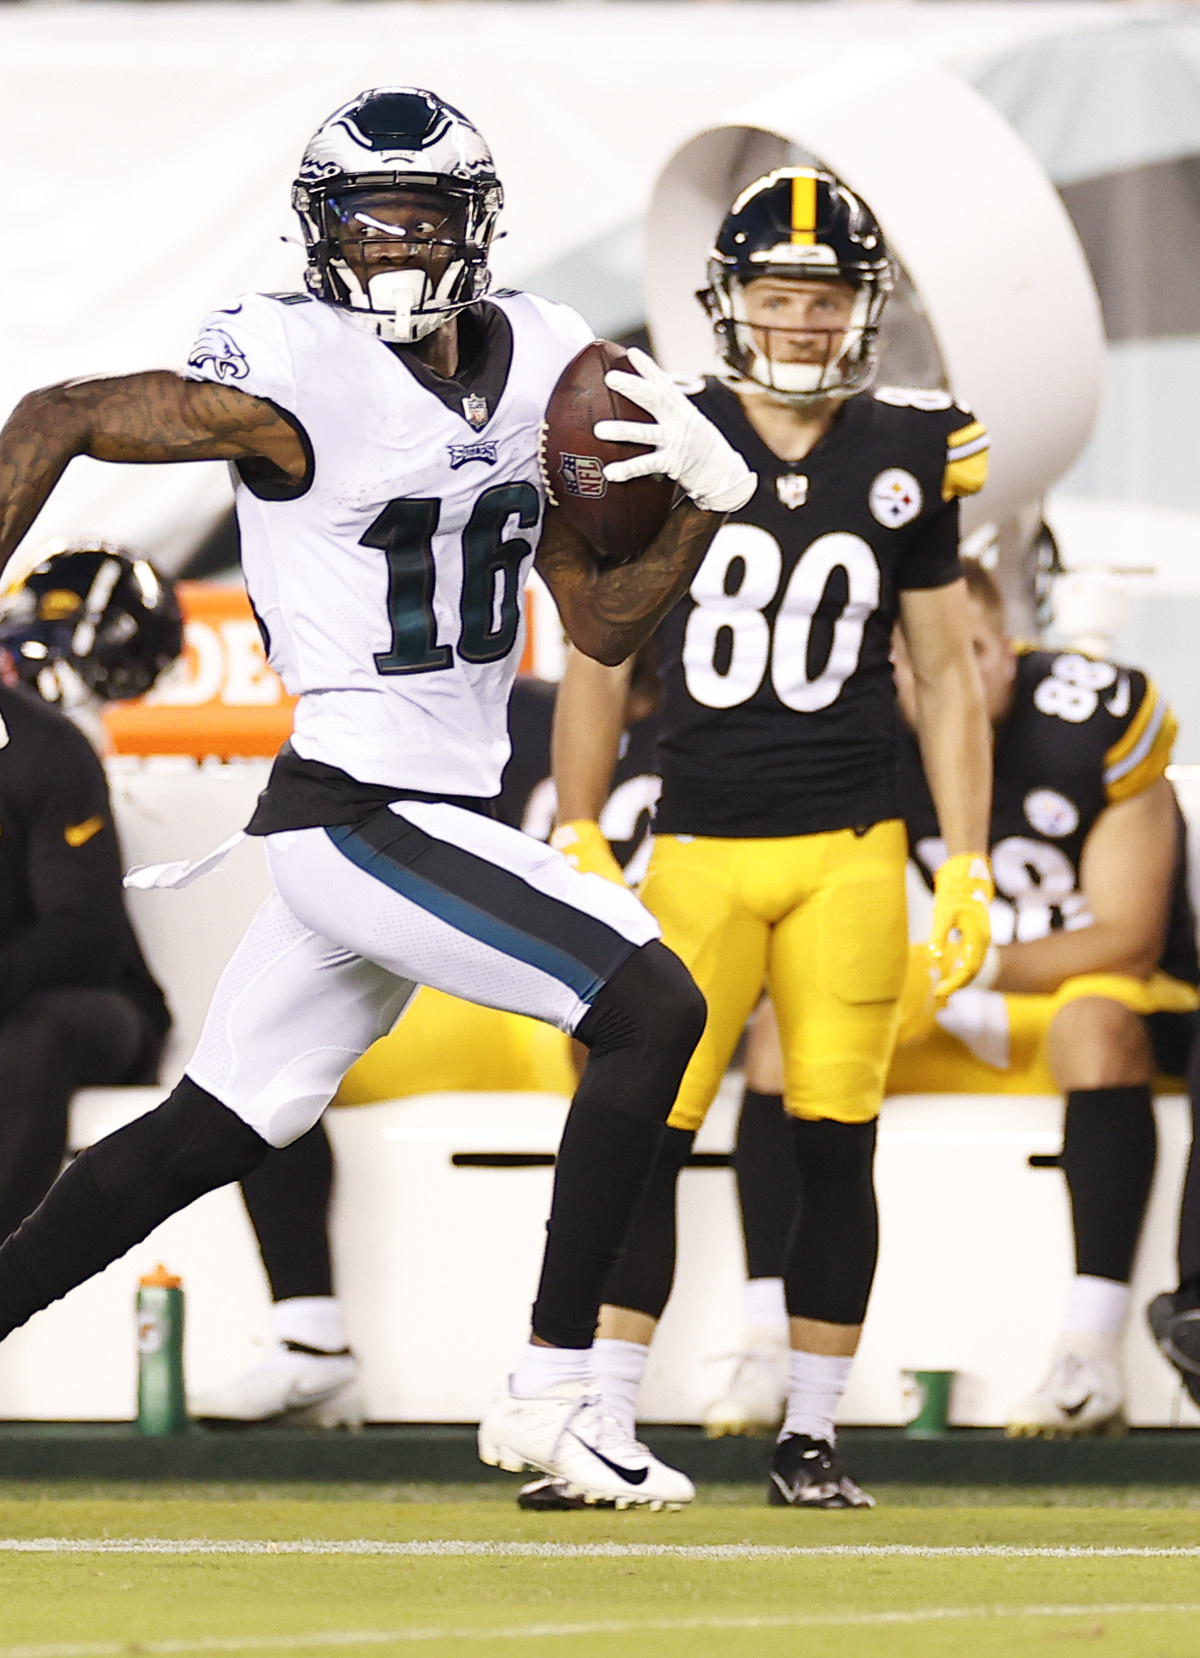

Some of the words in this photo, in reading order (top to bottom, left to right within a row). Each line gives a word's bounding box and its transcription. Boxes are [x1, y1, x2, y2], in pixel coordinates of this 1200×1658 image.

[577, 460, 601, 494] NFL
[358, 481, 540, 676] 16
[682, 522, 881, 714] 80
